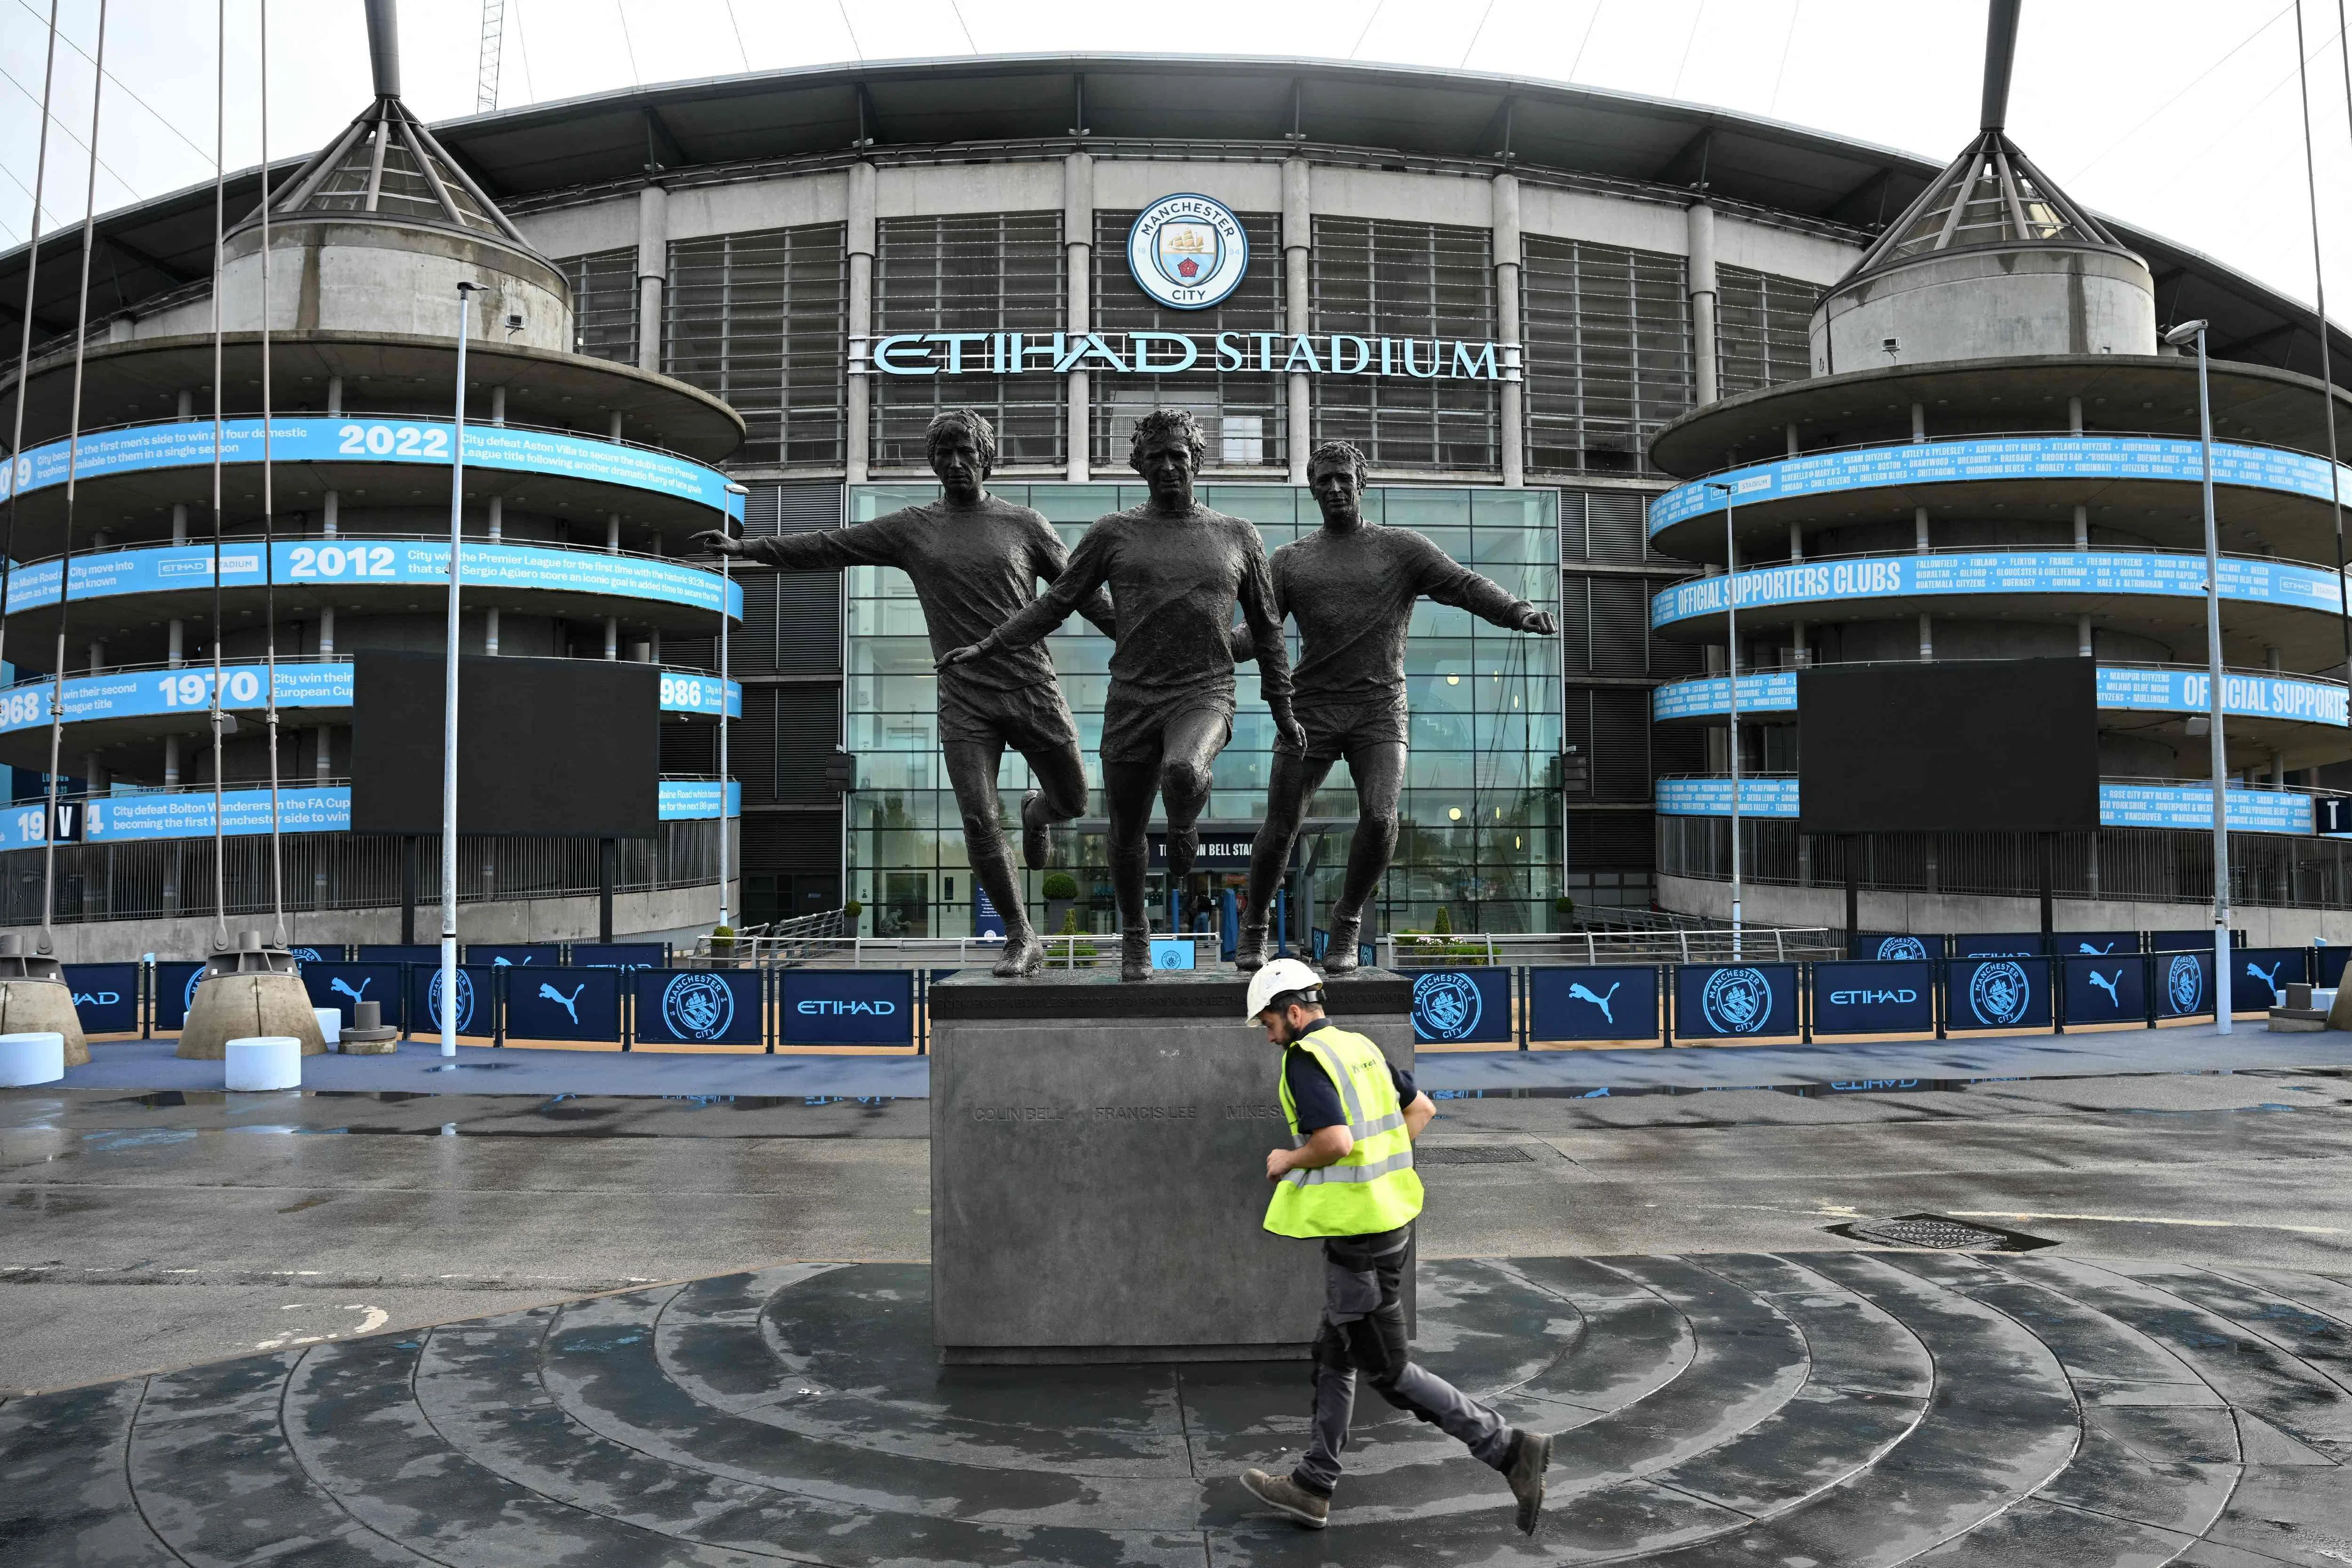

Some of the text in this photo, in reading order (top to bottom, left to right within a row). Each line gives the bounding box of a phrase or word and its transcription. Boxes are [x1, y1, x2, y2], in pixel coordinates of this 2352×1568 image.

[1141, 202, 1235, 237] MANCHESTER
[1172, 290, 1206, 300] CITY
[874, 331, 1498, 380] ETIHAD STADIUM
[38, 454, 52, 466] City
[84, 444, 99, 454] the
[100, 441, 119, 452] first
[151, 434, 174, 445] side
[188, 431, 208, 441] win
[226, 429, 249, 439] four
[251, 427, 307, 438] domestic
[339, 424, 449, 458] 2022
[38, 444, 239, 478] trophies to them in single season
[461, 434, 699, 482] City defeat Aston Villa to secure the Premier
[461, 446, 646, 480] League title following another dramatic
[1781, 443, 2041, 473] ASHTON-UNDER-LYNE CITY BLUES
[1848, 461, 1900, 474] BOLTON BOSTON
[1888, 470, 1907, 480] BLUES
[1742, 479, 1767, 490] STADIUM
[70, 561, 134, 578] City move into
[162, 562, 204, 572] ETIHAD
[290, 547, 396, 577] 2012
[408, 549, 687, 584] City Premier League for the first time with the historic
[1916, 557, 2074, 569] FALLOWFIELD FINLAND FLIXTON FRANCE
[1916, 568, 2145, 579] GIBRALTAR GLOUCESTER GOA GORTON
[19, 578, 39, 589] Maine
[86, 577, 117, 588] known
[408, 564, 432, 573] that
[461, 565, 493, 577] Sergio
[500, 566, 536, 579] Agüero
[540, 571, 568, 581] score
[569, 573, 581, 582] an
[583, 574, 610, 585] iconic
[611, 576, 628, 587] goal
[637, 581, 661, 591] added
[662, 584, 676, 594] time
[684, 589, 702, 599] secure
[1678, 579, 1722, 615] OFFICIAL
[1724, 566, 1828, 606] SUPPORTERS
[1834, 561, 1900, 594] CLUBS
[2002, 578, 2036, 587] GUERNSEY
[273, 673, 321, 685] City win
[2110, 671, 2139, 681] MANIPUR
[79, 687, 100, 698] their
[102, 683, 136, 695] second
[159, 671, 259, 706] 1970
[273, 686, 330, 699] European
[2106, 682, 2148, 692] MILANO BLUE
[2184, 675, 2269, 713] OFICIAL
[64, 703, 93, 714] league
[95, 699, 112, 709] title
[677, 789, 692, 799] Road
[693, 789, 707, 799] which
[2109, 790, 2126, 799] ROSE
[2127, 791, 2140, 799] CITY
[2155, 792, 2174, 801] BLUES
[113, 798, 350, 817] City defeat Bolton the FA Cup
[2112, 801, 2191, 812] YORKSHIRE SOUTHPORT
[58, 806, 72, 837] V
[113, 819, 163, 831] becoming
[165, 817, 183, 828] the
[185, 816, 208, 827] first
[284, 813, 309, 823] side
[312, 813, 324, 822] to
[326, 812, 350, 822] win
[2124, 812, 2211, 823] VANCOUVER WARRINGTON
[2327, 801, 2339, 829] T
[1209, 844, 1231, 856] BELL
[1882, 937, 1918, 957] MANCHESTER
[1975, 963, 2019, 991] MANCHESTER
[2172, 956, 2196, 983] MANCHESTER
[669, 975, 722, 1003] MANCHESTER
[1414, 974, 1469, 1004] MANCHESTER
[1709, 970, 1760, 998] MANCHESTER
[1830, 989, 1917, 1004] ETIHAD
[797, 1001, 895, 1015] ETIHAD
[1998, 1012, 2014, 1024] CITY
[695, 1028, 715, 1039] CITY
[1442, 1027, 1463, 1039] CITY
[1735, 1020, 1754, 1032] CITY
[974, 1107, 1020, 1122] COLIN
[1025, 1107, 1065, 1122] BELL
[1095, 1106, 1163, 1120] FRANCIS
[1168, 1106, 1197, 1120] LEE
[1226, 1105, 1265, 1119] MIKE
